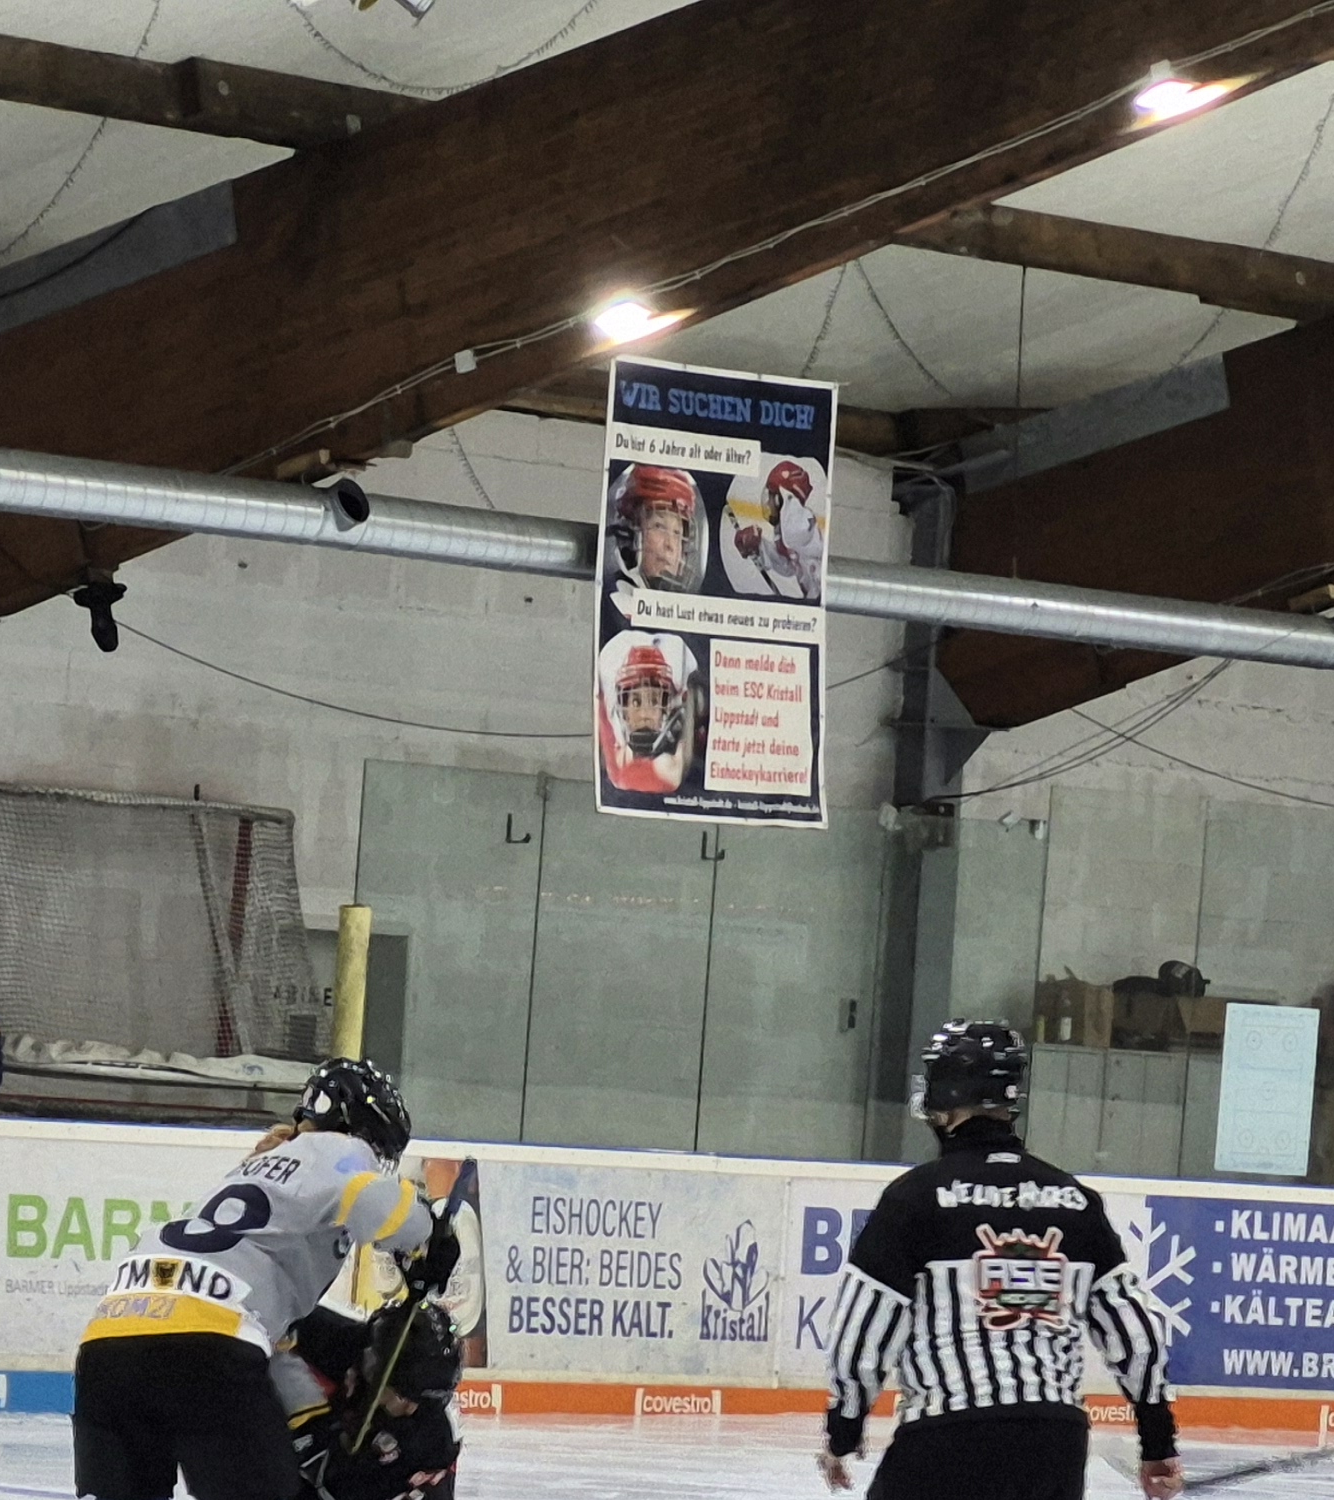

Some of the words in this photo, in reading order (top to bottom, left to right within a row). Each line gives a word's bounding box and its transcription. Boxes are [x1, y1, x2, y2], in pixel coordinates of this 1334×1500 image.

[620, 380, 661, 411] WIR
[668, 388, 752, 422] SUCHEN
[760, 400, 815, 430] DICH!
[616, 433, 629, 448] Du
[630, 435, 645, 451] bist
[649, 439, 655, 452] 6
[659, 440, 685, 457] Jahre
[688, 444, 701, 458] alt
[704, 446, 722, 461] oder
[725, 448, 751, 465] älter?
[637, 600, 652, 616] Du
[655, 601, 674, 617] hast
[676, 604, 695, 621] Lust
[698, 609, 724, 624] etwas
[727, 613, 754, 626] neues
[758, 616, 769, 628] zu
[772, 613, 817, 632] probieren?
[715, 650, 741, 669] Dann
[745, 654, 775, 672] melde
[778, 655, 796, 674] dich
[714, 678, 739, 696] beim
[744, 681, 764, 699] ESC
[767, 684, 802, 702] Kristall
[714, 706, 759, 729] Lippstadt
[761, 710, 779, 727] und
[712, 737, 740, 753] starte
[742, 738, 765, 758] jetzt
[769, 739, 799, 756] deine
[710, 761, 807, 786] Eishockeykarriere!
[531, 1196, 663, 1240] EISHOCKEY
[506, 1245, 524, 1284] &
[532, 1247, 591, 1287] BIER:
[598, 1249, 683, 1291] BEIDES
[5, 1278, 55, 1295] BARMER
[508, 1295, 605, 1337] BESSER
[611, 1299, 674, 1340] KALT.
